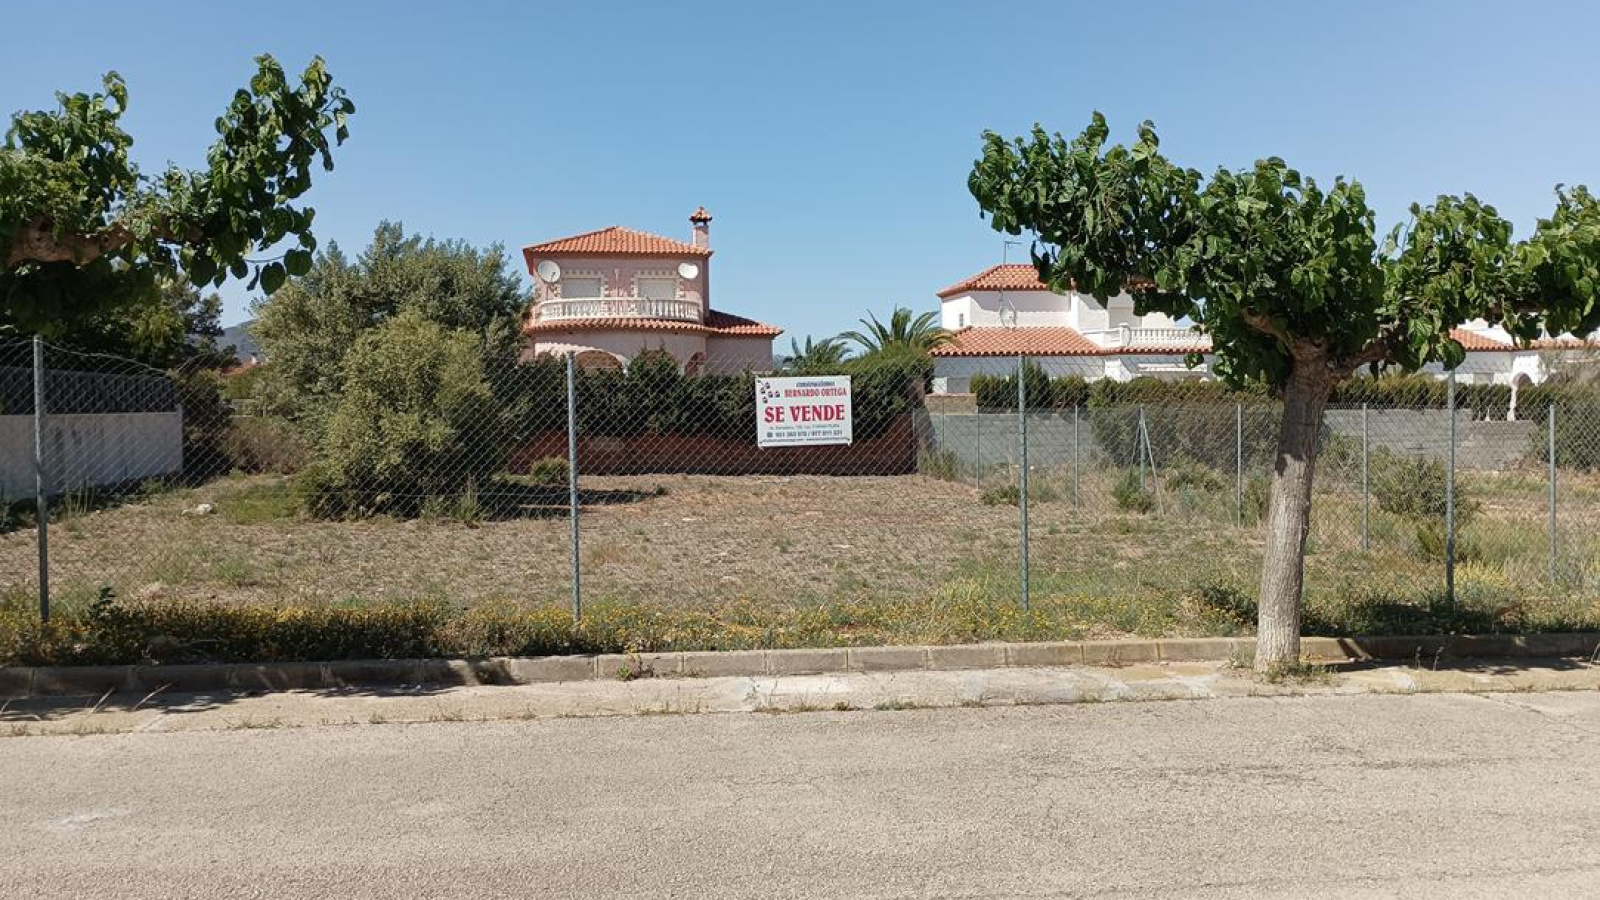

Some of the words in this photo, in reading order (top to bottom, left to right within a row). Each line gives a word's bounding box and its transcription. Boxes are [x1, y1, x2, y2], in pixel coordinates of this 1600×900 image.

[784, 388, 820, 398] BERNARDO
[821, 387, 847, 397] ORTEGA
[764, 406, 785, 422] SE
[789, 405, 845, 421] VENDE
